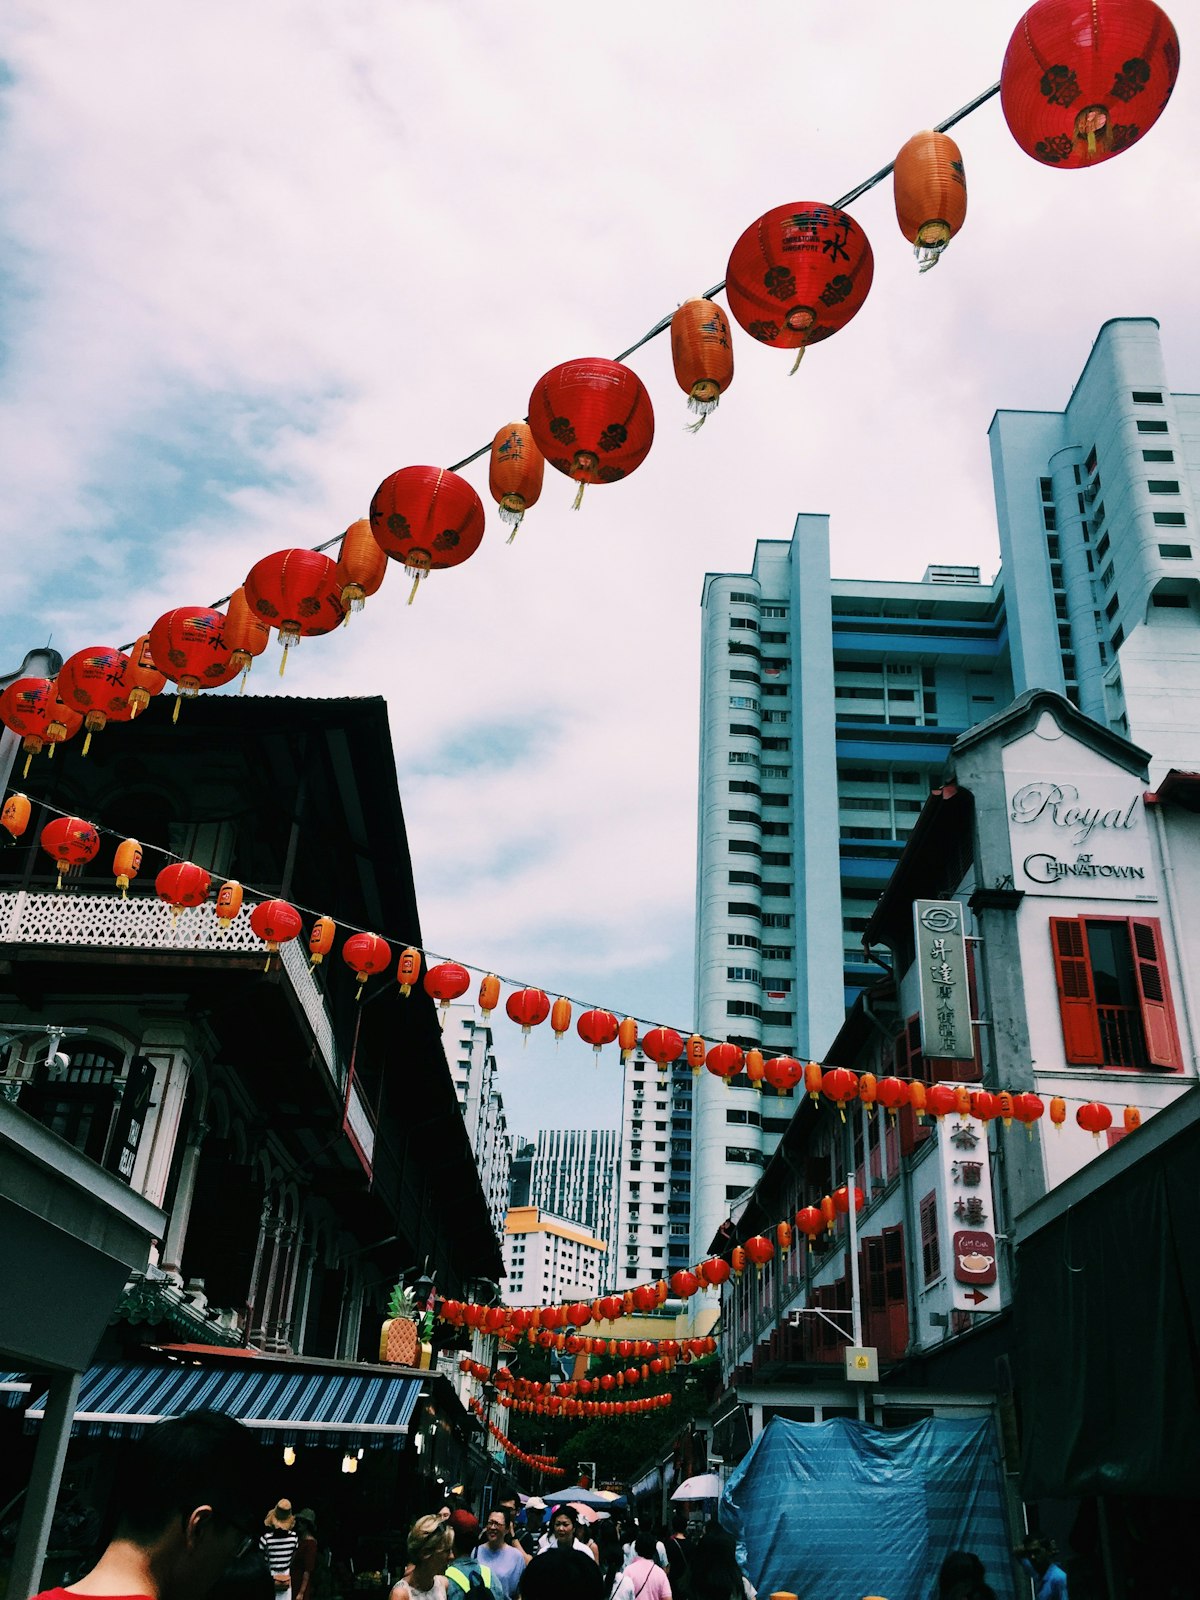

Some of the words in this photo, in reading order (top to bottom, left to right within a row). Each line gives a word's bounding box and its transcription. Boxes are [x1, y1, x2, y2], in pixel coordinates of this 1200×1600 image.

[1011, 782, 1139, 846] Royal
[1023, 853, 1145, 884] CHINATOWN
[1077, 853, 1093, 863] AT
